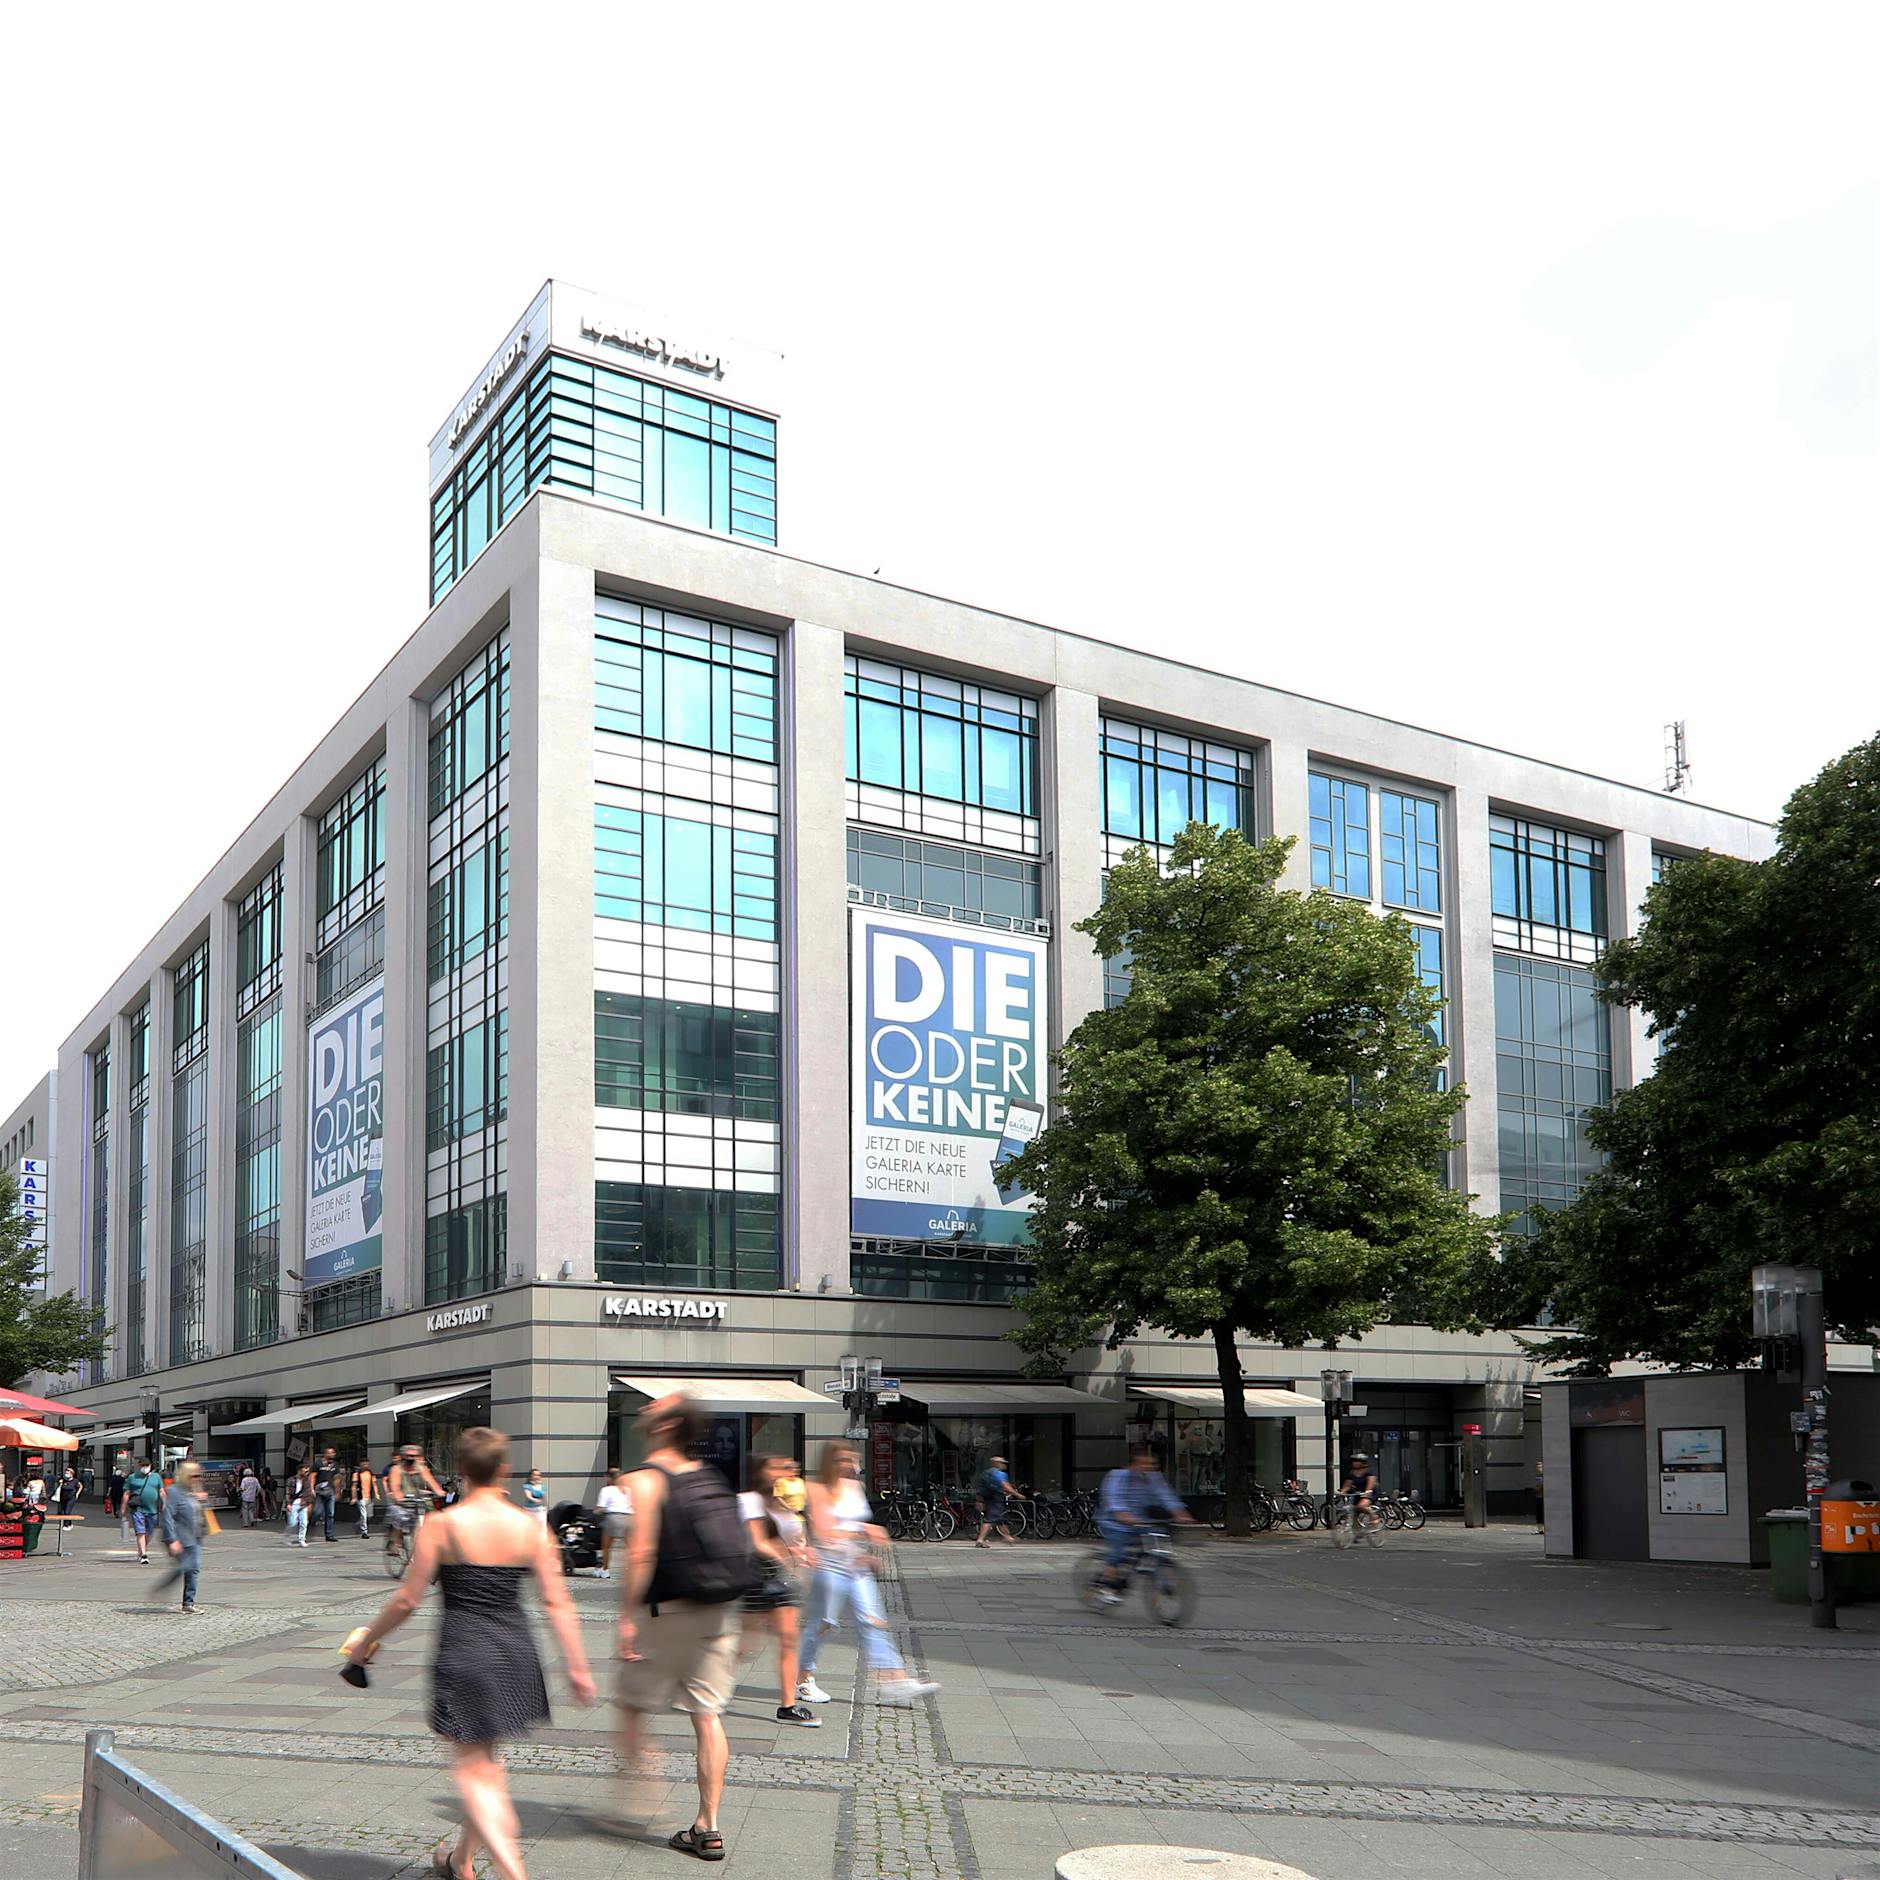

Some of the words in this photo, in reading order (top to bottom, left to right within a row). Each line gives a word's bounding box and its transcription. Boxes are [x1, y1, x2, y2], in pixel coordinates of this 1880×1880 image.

[448, 330, 529, 449] KARSTADT
[873, 931, 1030, 1041] DIE
[315, 994, 383, 1108] DIE
[870, 1024, 1030, 1096] ODER
[313, 1079, 382, 1154] ODER
[873, 1080, 1006, 1133] KEINE
[1008, 1120, 1034, 1133] GALERIA
[865, 1135, 901, 1152] JETZT
[905, 1139, 926, 1154] DIE
[930, 1142, 967, 1159] NEUE
[313, 1134, 369, 1192] KEINE
[865, 1155, 923, 1174] GALERIA
[927, 1162, 967, 1178] KARTE
[865, 1175, 930, 1195] SICHERN!
[335, 1190, 352, 1207] NEUE
[311, 1216, 333, 1233] GALERIA
[334, 1207, 352, 1225] KARTE
[928, 1219, 978, 1233] GALERIA
[310, 1231, 336, 1250] SICHERN!
[333, 1256, 355, 1272] GALERIA
[426, 1303, 488, 1332] KARSTADT
[604, 1297, 728, 1319] KARSTADT
